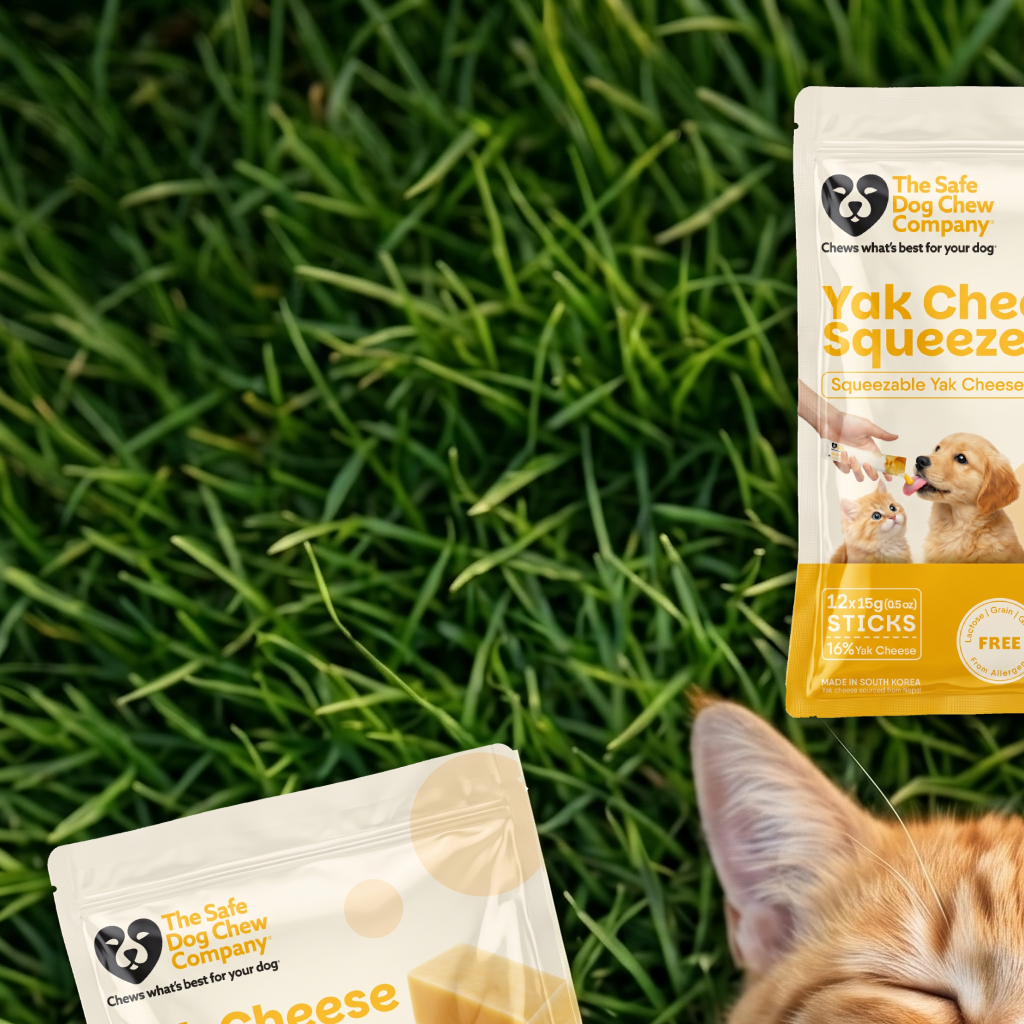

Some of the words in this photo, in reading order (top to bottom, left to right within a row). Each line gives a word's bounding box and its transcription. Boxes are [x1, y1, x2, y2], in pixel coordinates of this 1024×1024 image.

[892, 175, 930, 193] The
[935, 175, 977, 193] Safe
[893, 196, 933, 218] Dog
[938, 195, 994, 213] Chew
[822, 242, 859, 252] Chews
[899, 242, 923, 252] best
[926, 242, 942, 252] for
[945, 245, 970, 255] your
[822, 284, 912, 319] Yak
[832, 377, 925, 394] Squeezable
[930, 378, 956, 391] Yak
[962, 378, 1023, 391] Cheese
[828, 615, 916, 632] STICKS
[964, 612, 985, 643] Lactose
[991, 607, 1013, 615] Grain
[876, 646, 916, 655] Cheese
[979, 637, 1020, 649] FREE
[970, 657, 987, 674] From
[160, 910, 202, 931] The
[204, 897, 248, 922] Safe
[166, 931, 209, 956] Dog
[212, 916, 268, 940] Chew
[107, 991, 145, 1007] Chews
[182, 975, 209, 989] best
[209, 972, 226, 983] for
[228, 966, 254, 981] your
